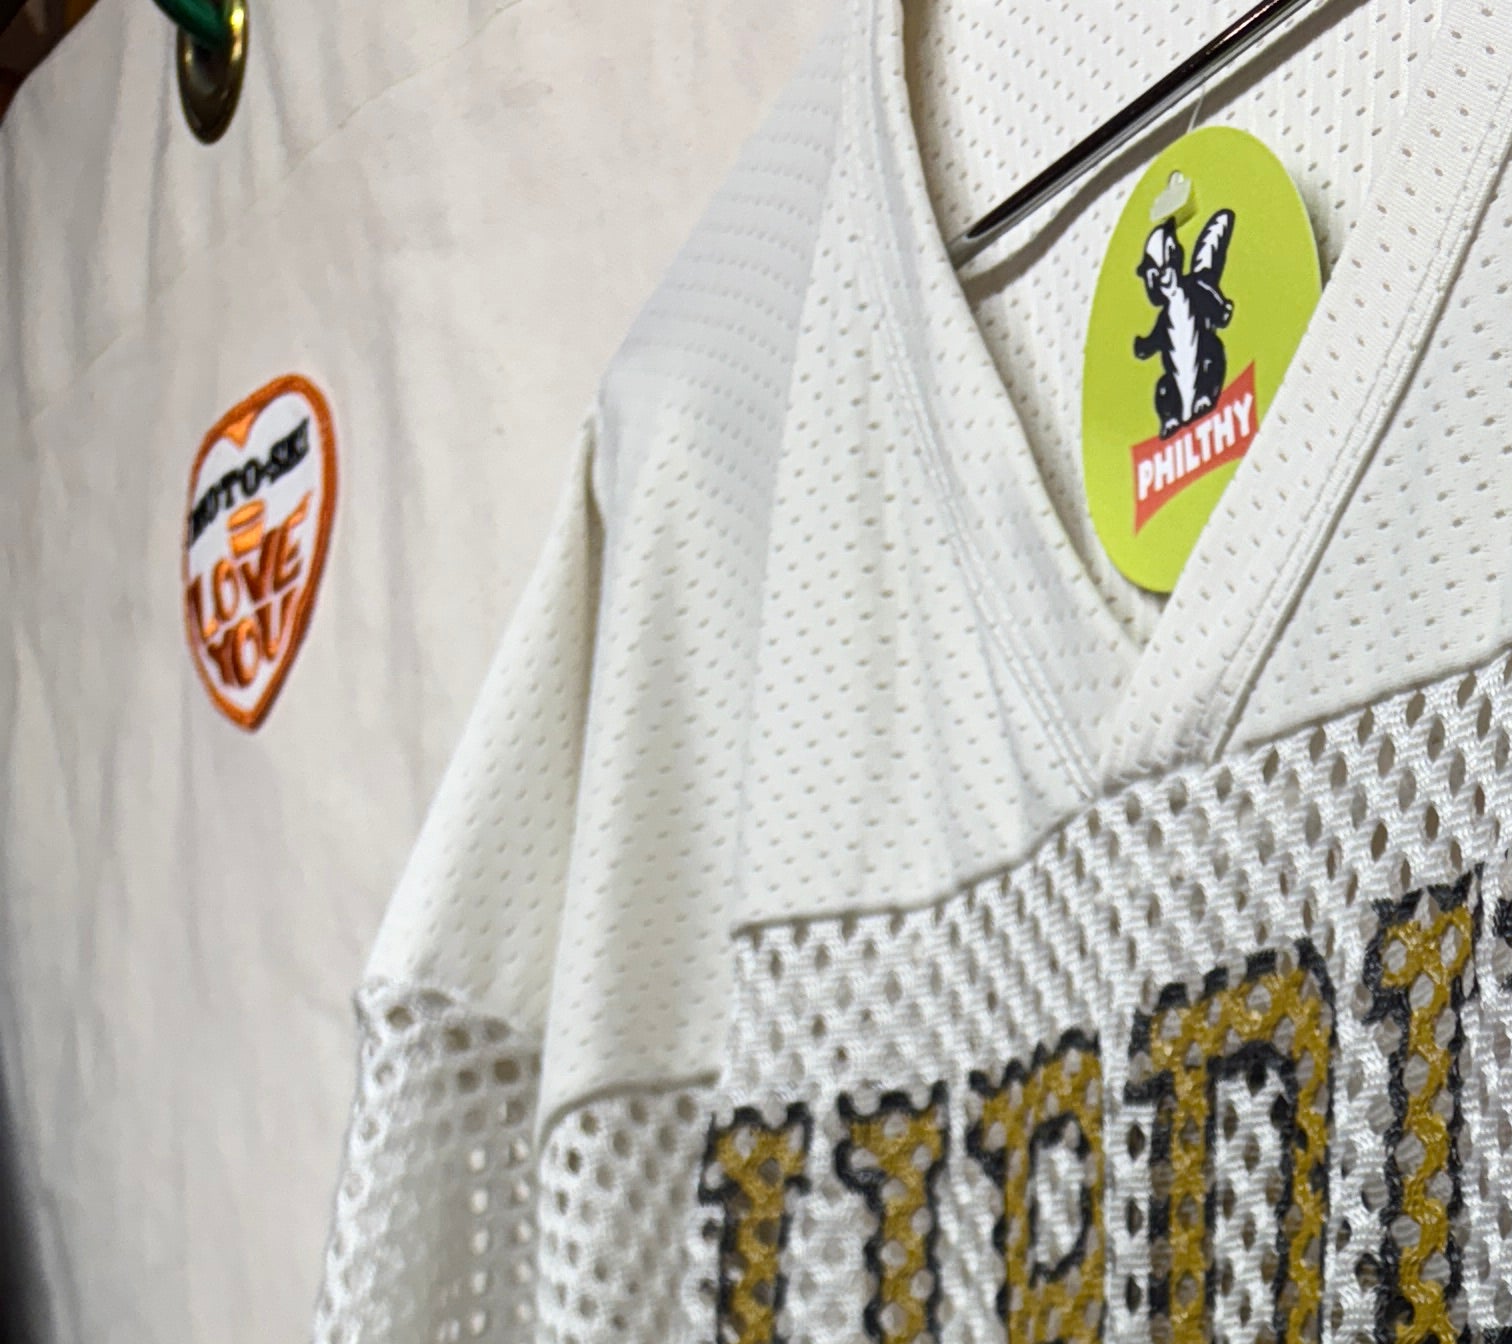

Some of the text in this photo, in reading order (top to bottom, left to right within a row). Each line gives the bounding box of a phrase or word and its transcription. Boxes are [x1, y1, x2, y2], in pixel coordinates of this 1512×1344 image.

[1136, 391, 1254, 501] PHILTHY
[187, 490, 313, 640] LOVE
[207, 587, 299, 688] YOU
